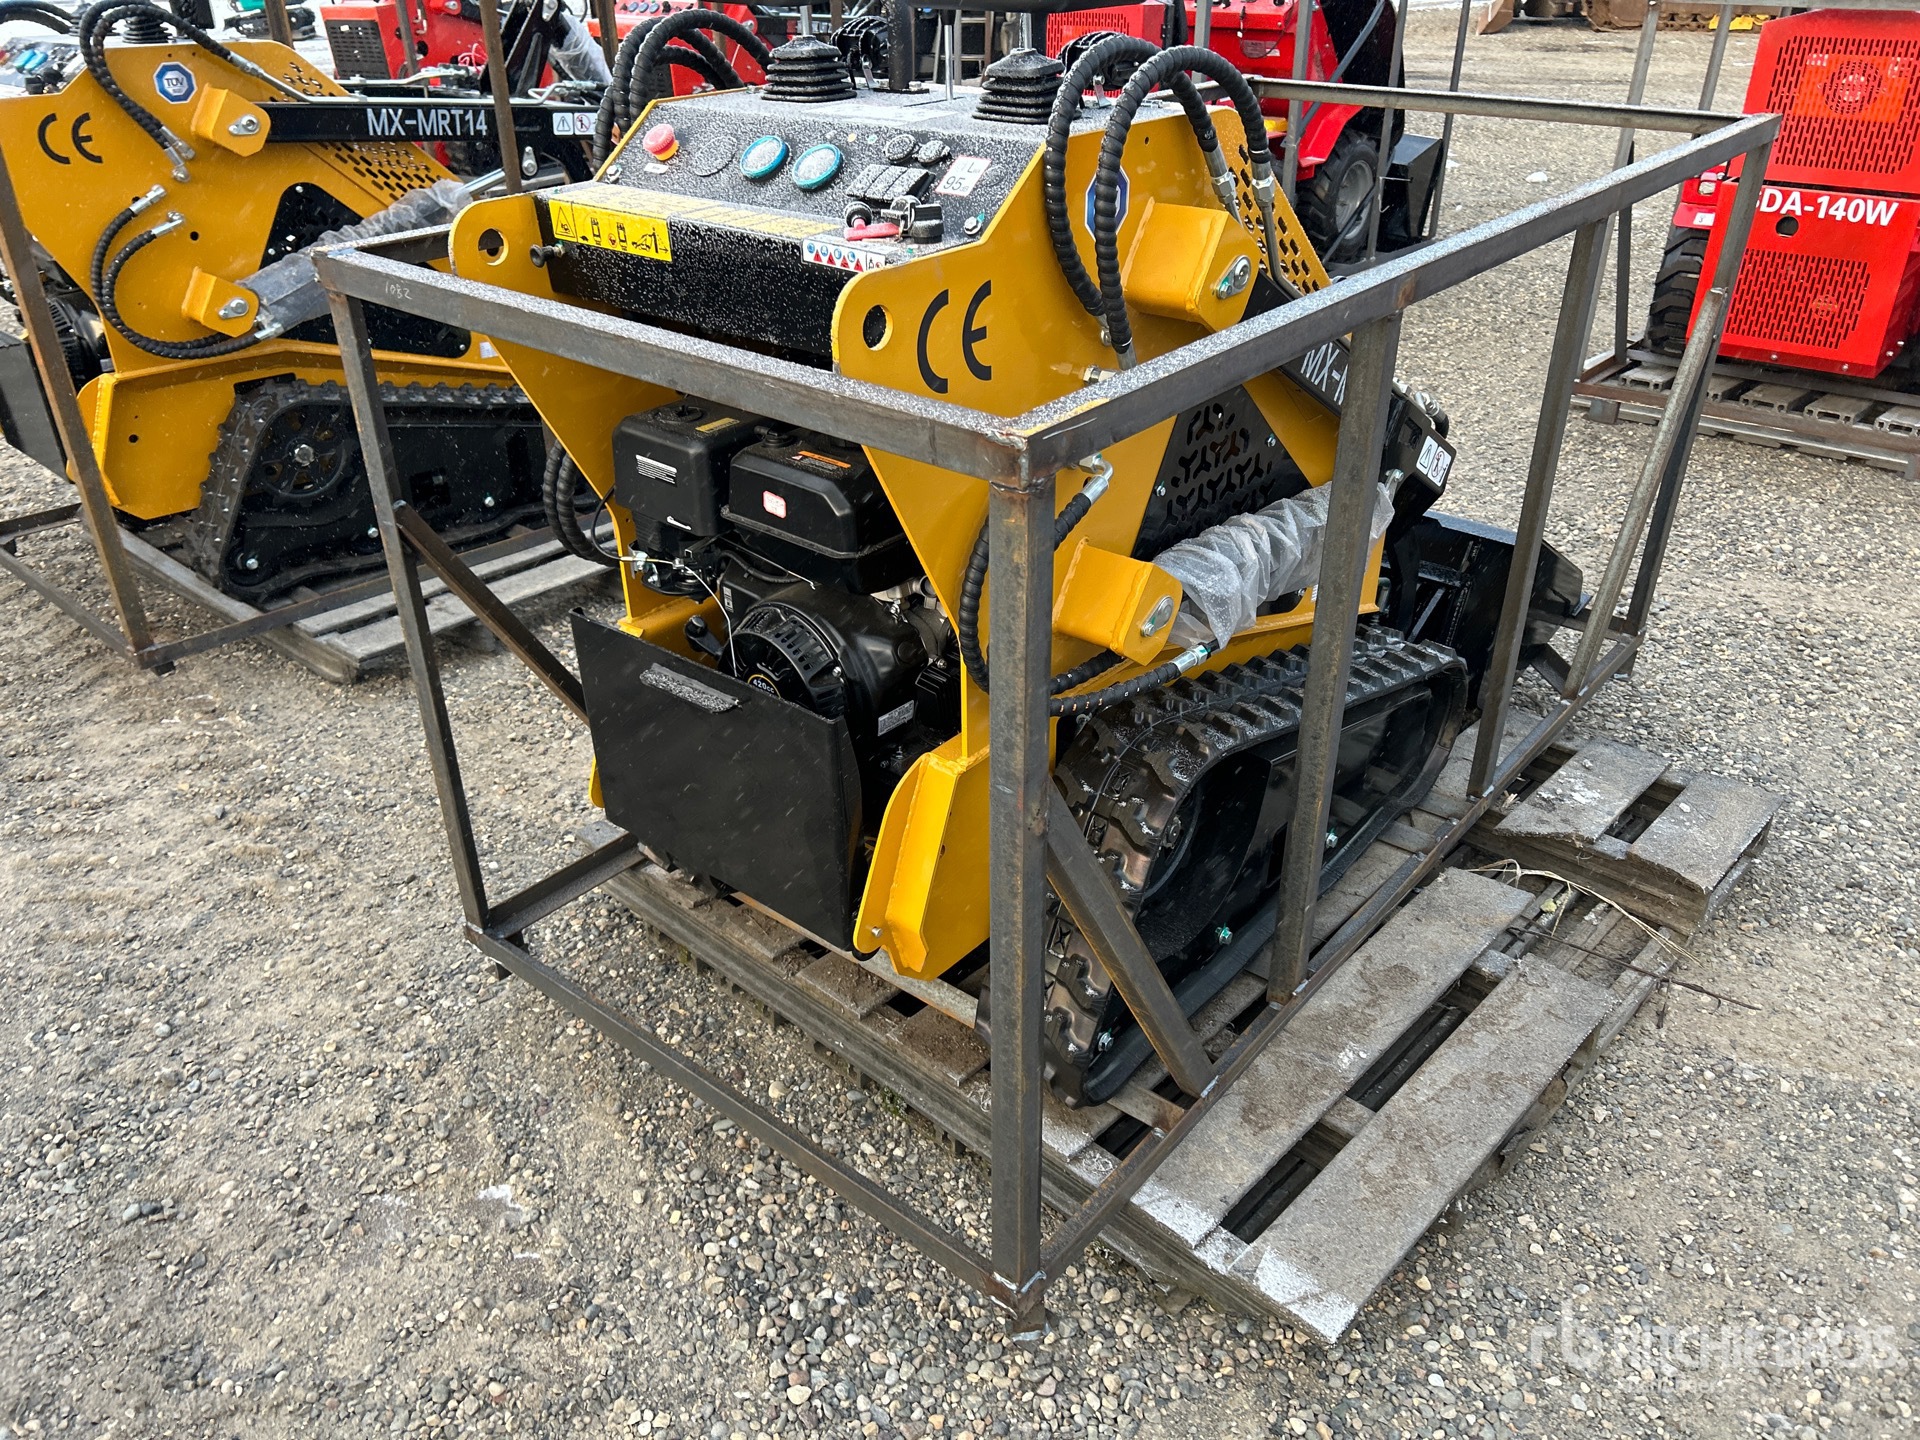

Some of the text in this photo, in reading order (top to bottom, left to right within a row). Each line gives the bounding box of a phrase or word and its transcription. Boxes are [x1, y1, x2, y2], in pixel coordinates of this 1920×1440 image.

[37, 111, 104, 165] CE
[366, 107, 488, 136] MX-MRT14
[917, 279, 992, 394] CE
[752, 679, 775, 694] 420cc
